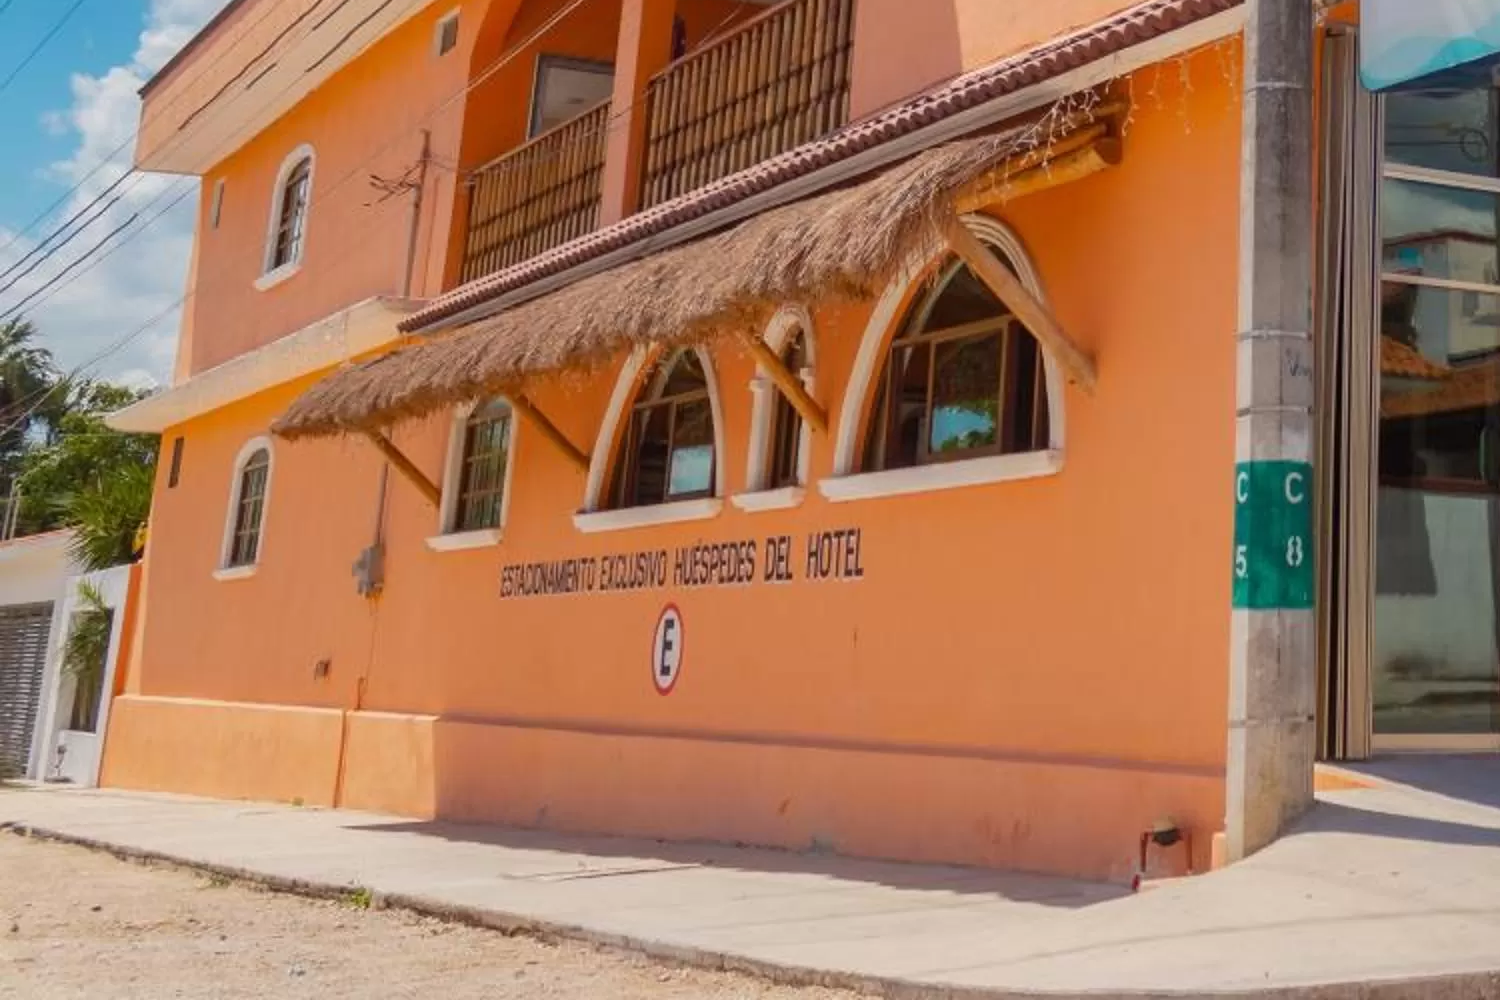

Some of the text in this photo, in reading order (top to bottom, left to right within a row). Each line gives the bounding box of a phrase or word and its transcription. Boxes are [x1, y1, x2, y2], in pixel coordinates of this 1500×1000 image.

[1285, 472, 1304, 504] C
[500, 557, 597, 597] ESTACIONAMIENTO
[599, 550, 668, 591] EXCLUSIVO
[764, 535, 793, 581] DEL
[806, 528, 864, 579] HOTEL
[1236, 545, 1248, 577] 5
[1286, 535, 1304, 567] 8
[660, 618, 675, 676] E
